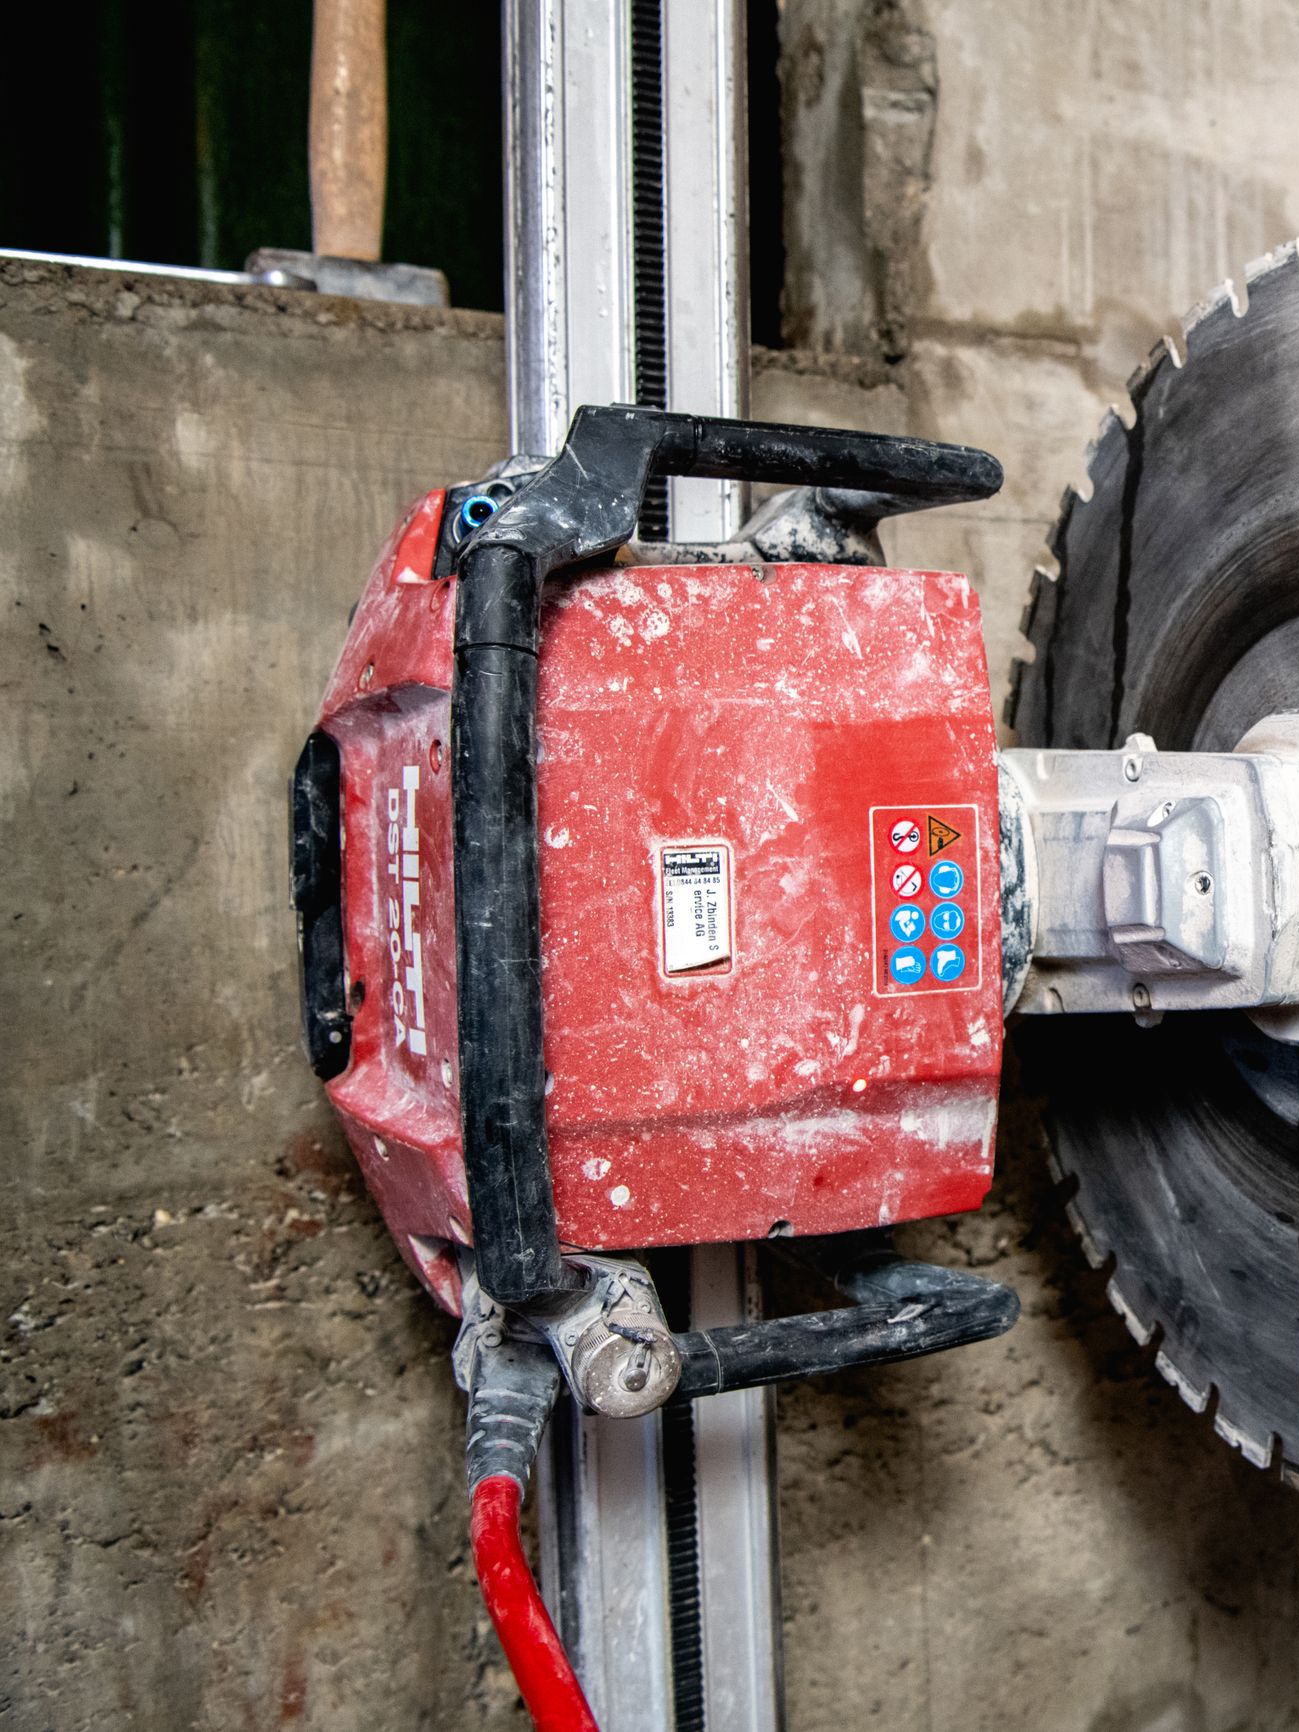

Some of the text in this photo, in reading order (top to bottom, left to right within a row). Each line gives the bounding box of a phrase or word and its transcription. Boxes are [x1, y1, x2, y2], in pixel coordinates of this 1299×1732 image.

[665, 852, 719, 865] HILTI
[403, 765, 427, 1056] HILTI
[693, 890, 706, 937] ervice AG
[706, 889, 717, 898] J.
[388, 788, 406, 1048] DST 20-CA
[706, 901, 718, 942] Zbinden
